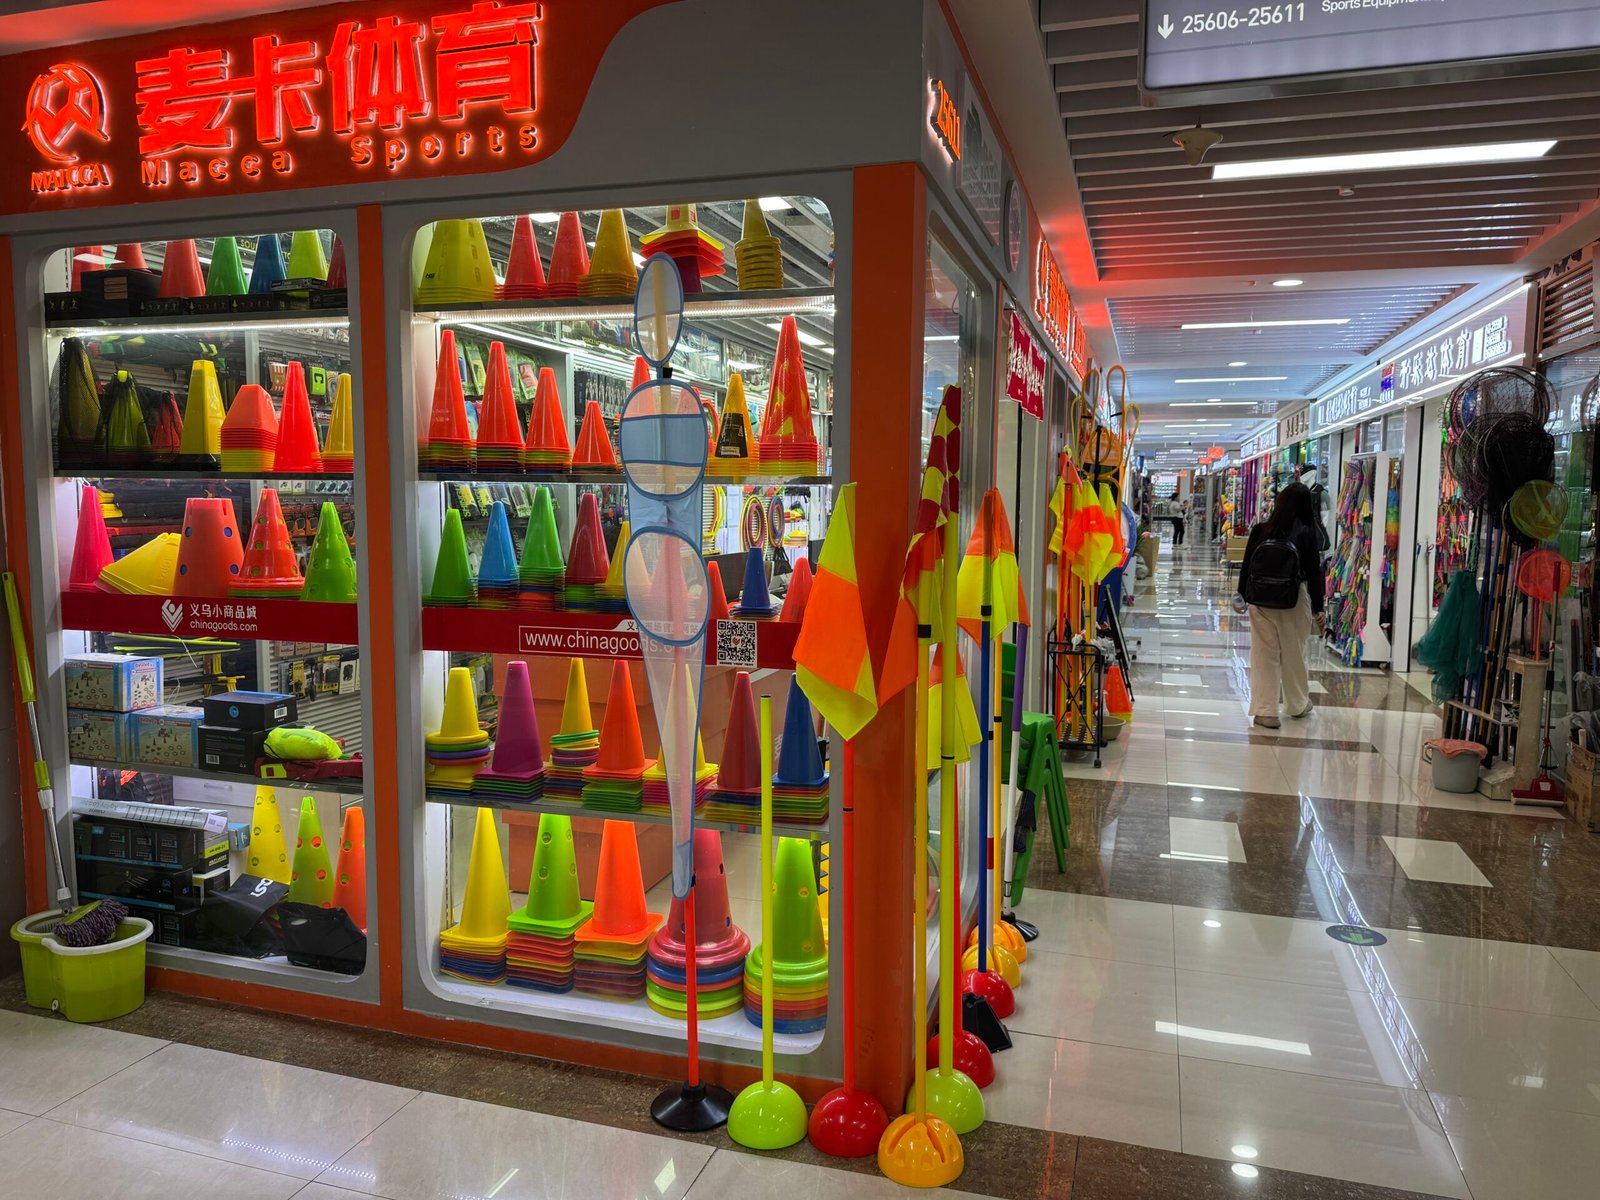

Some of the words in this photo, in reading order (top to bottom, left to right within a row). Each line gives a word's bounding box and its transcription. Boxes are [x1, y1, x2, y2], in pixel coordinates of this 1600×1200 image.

[1181, 2, 1305, 34] 25606-25611
[1321, 0, 1360, 14] Sports
[136, 1, 544, 156] 麦卡体育
[141, 151, 293, 188] Macca
[350, 122, 540, 170] Sports
[31, 163, 109, 193] MAICCA
[189, 602, 257, 620] 义乌小商品城
[189, 618, 258, 633] chinagoods.com
